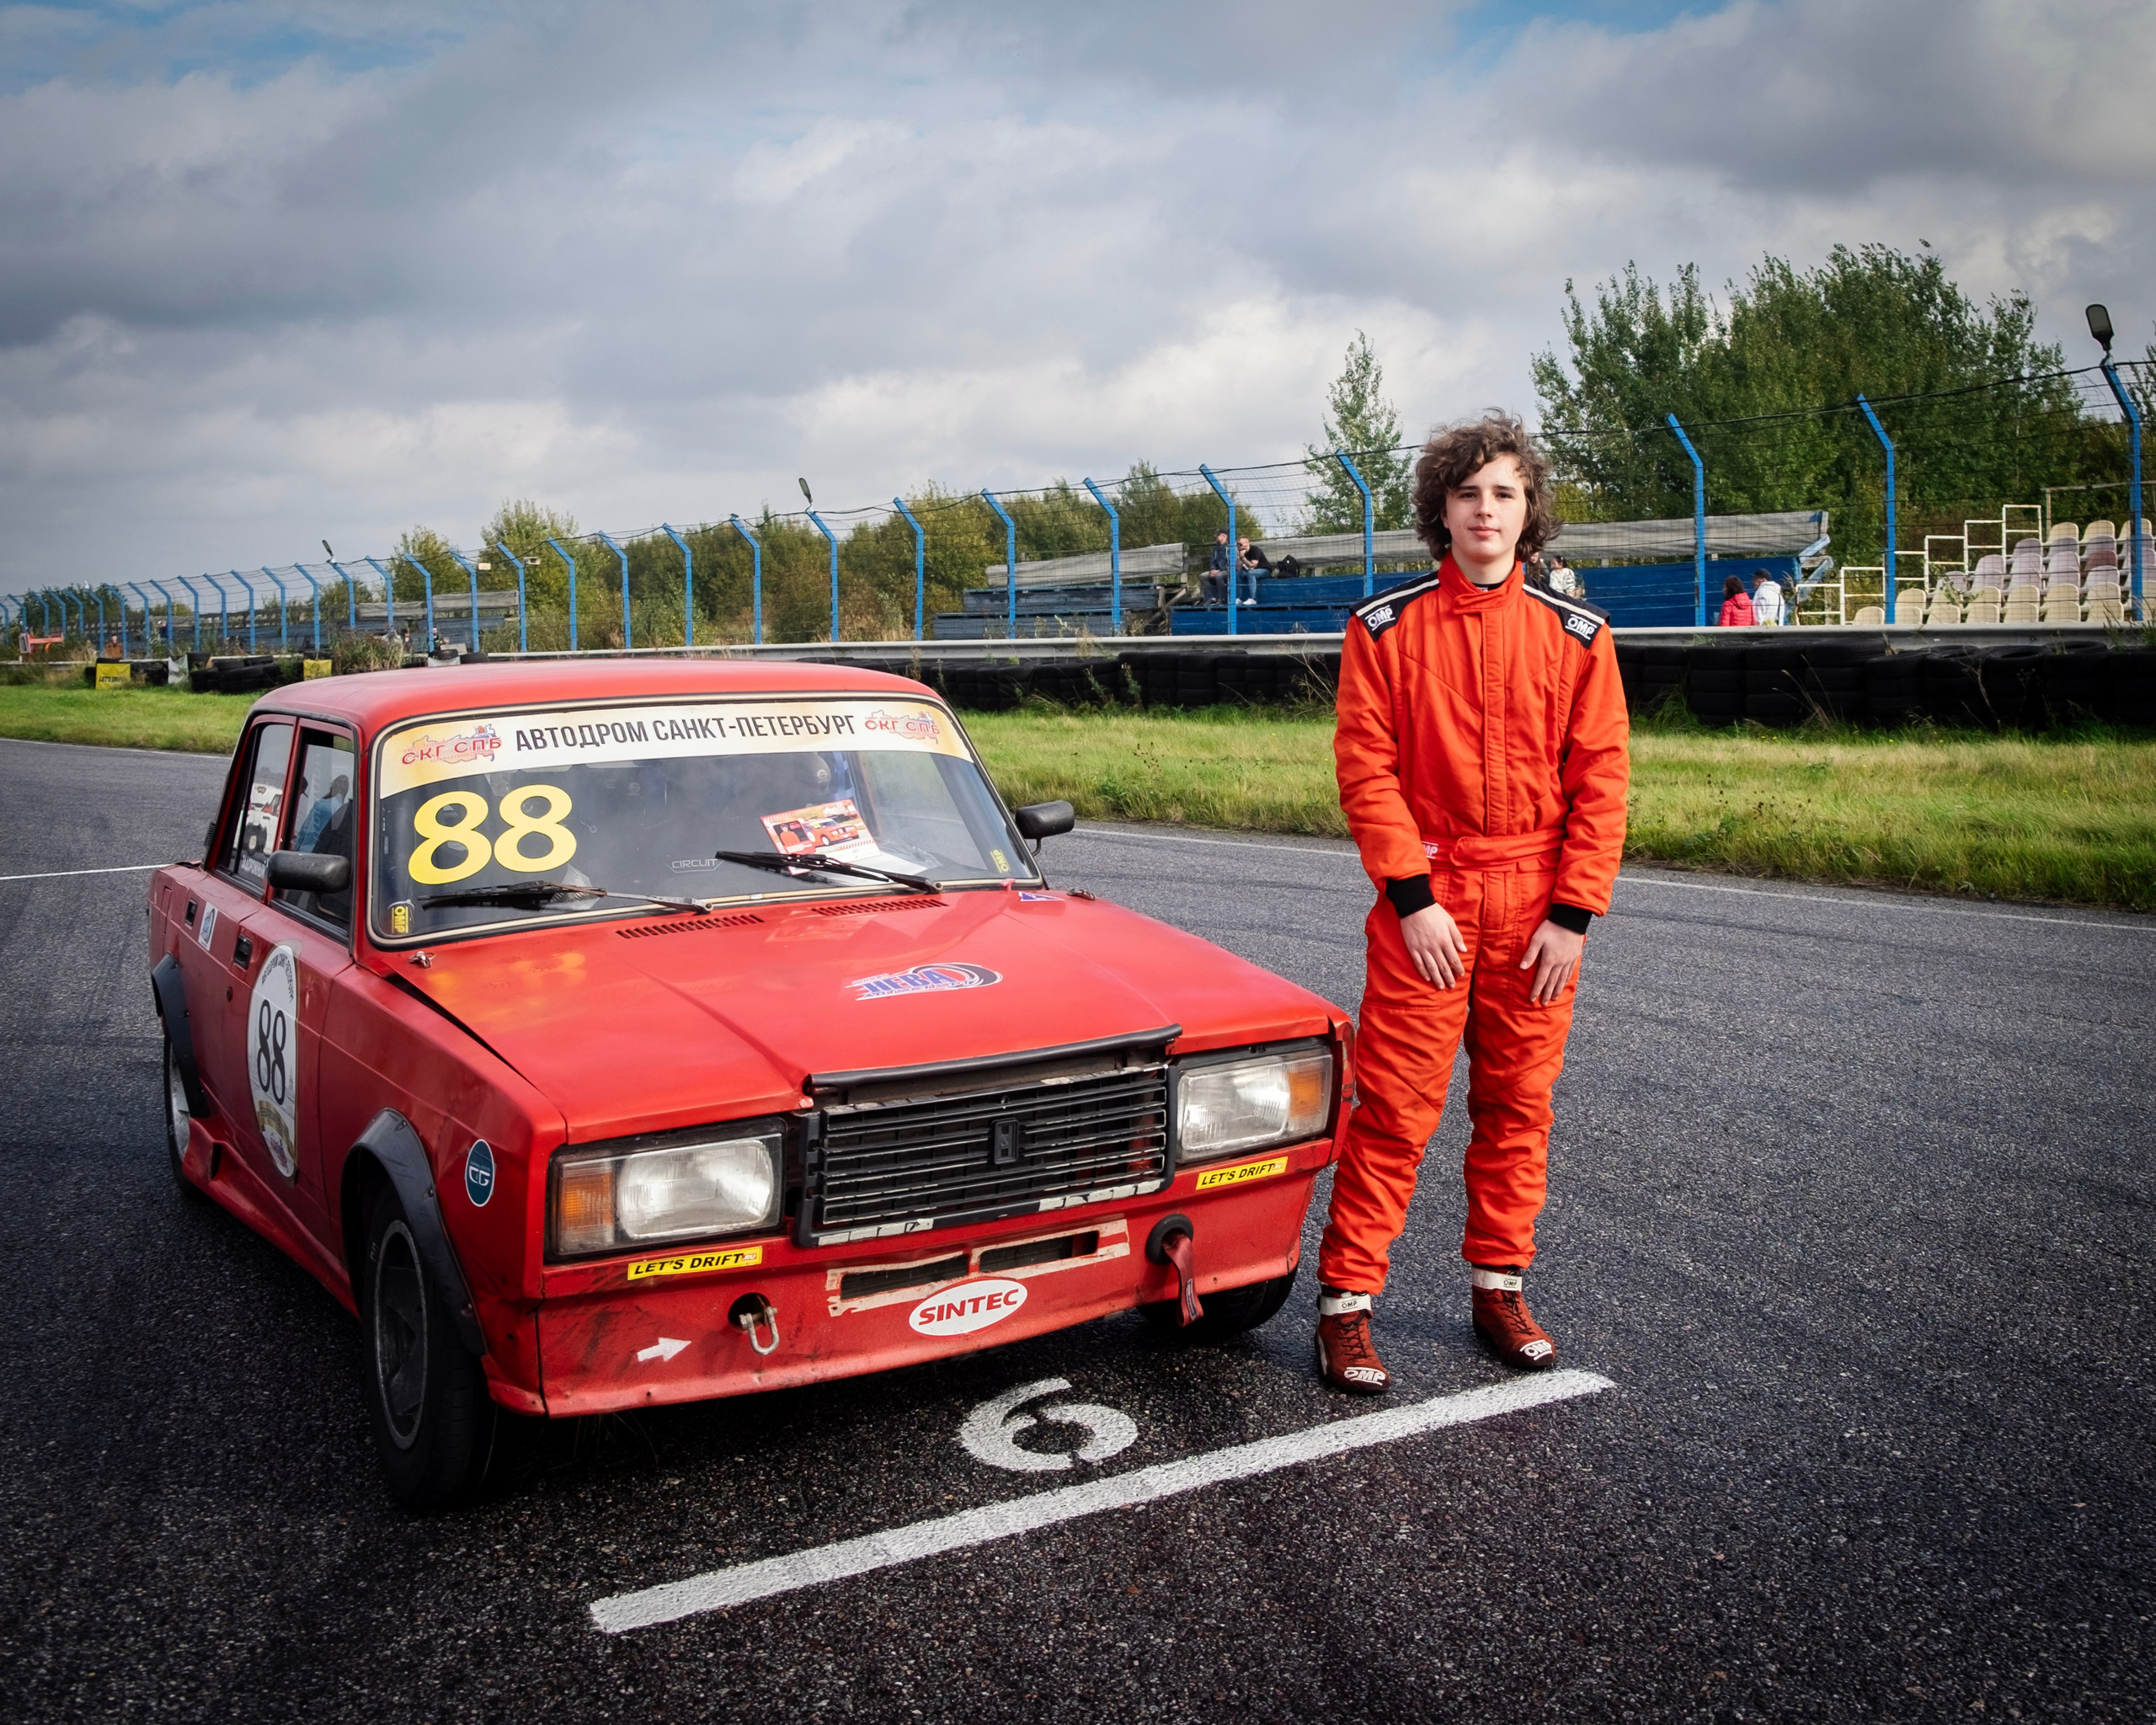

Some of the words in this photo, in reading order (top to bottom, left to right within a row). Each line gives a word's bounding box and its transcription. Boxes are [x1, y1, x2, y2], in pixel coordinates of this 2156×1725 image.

[1368, 607, 1393, 628] OMP
[1567, 617, 1595, 636] OMP
[515, 721, 649, 751] АВТОДРОМ
[652, 715, 856, 741] САНКТ-ПЕТЕРБУРГ
[864, 720, 899, 730] СКГ
[905, 722, 941, 734] СПБ
[402, 745, 446, 764] СКГ
[454, 737, 502, 753] СПБ
[408, 784, 577, 885] 88
[671, 858, 718, 868] CIRCUIT
[993, 849, 1009, 873] OMP
[394, 905, 406, 932] OMP
[863, 969, 958, 992] НЕВА
[257, 999, 286, 1106] 88
[1201, 1170, 1236, 1185] LET'S
[634, 1258, 685, 1275] LET'S
[918, 1289, 1019, 1326] SINTEC
[1342, 1300, 1358, 1309] OMP
[1524, 1341, 1552, 1357] OMP
[1343, 1370, 1386, 1382] OMP
[959, 1376, 1139, 1472] 6
